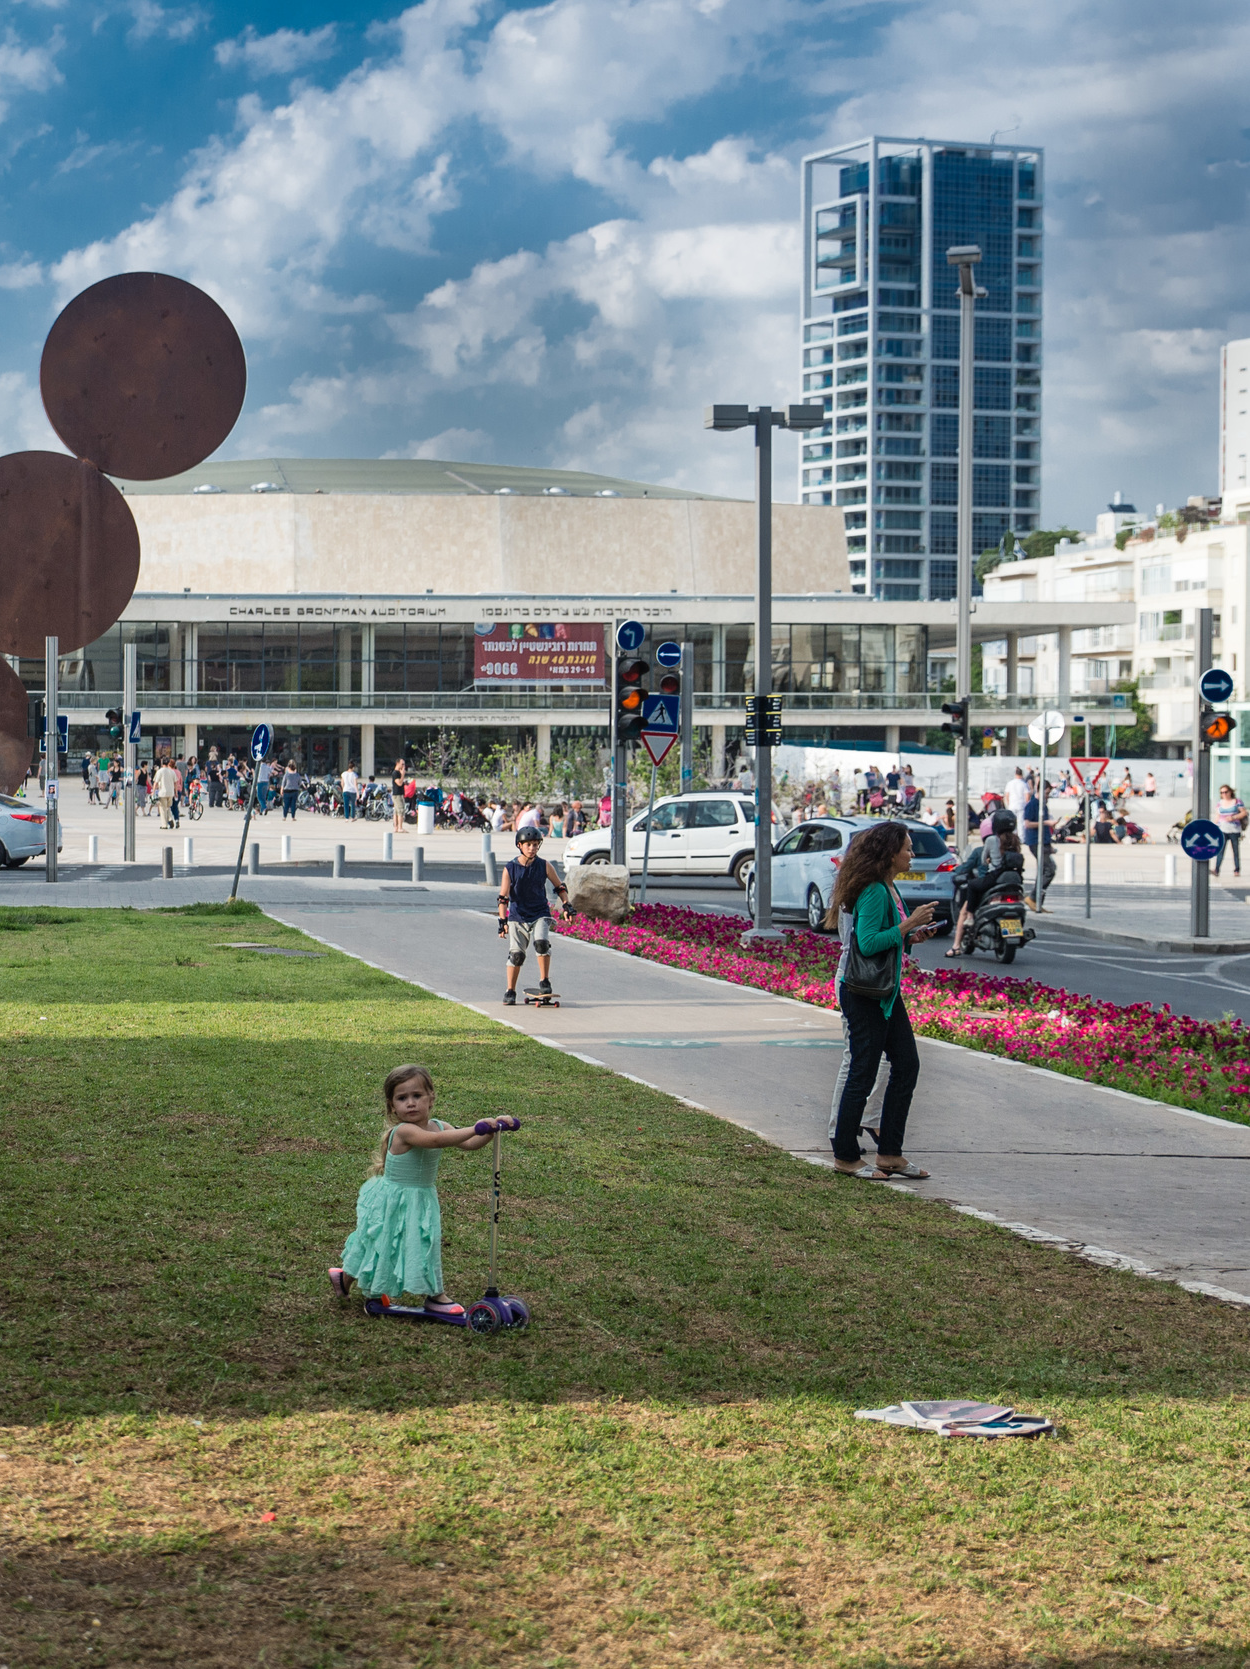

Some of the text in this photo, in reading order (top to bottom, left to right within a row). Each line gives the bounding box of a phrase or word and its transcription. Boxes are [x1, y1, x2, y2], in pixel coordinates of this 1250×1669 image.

[229, 607, 447, 616] CHARLES BRONFMAN AUDITORIUM
[481, 607, 530, 617] ברונפמן
[593, 607, 640, 617] התרבות
[643, 607, 672, 617] היכל
[482, 639, 597, 654] תחרות רובינשטיין לפסנתר
[528, 655, 597, 665] חוגגת 40 שנה
[549, 666, 569, 674] במאי
